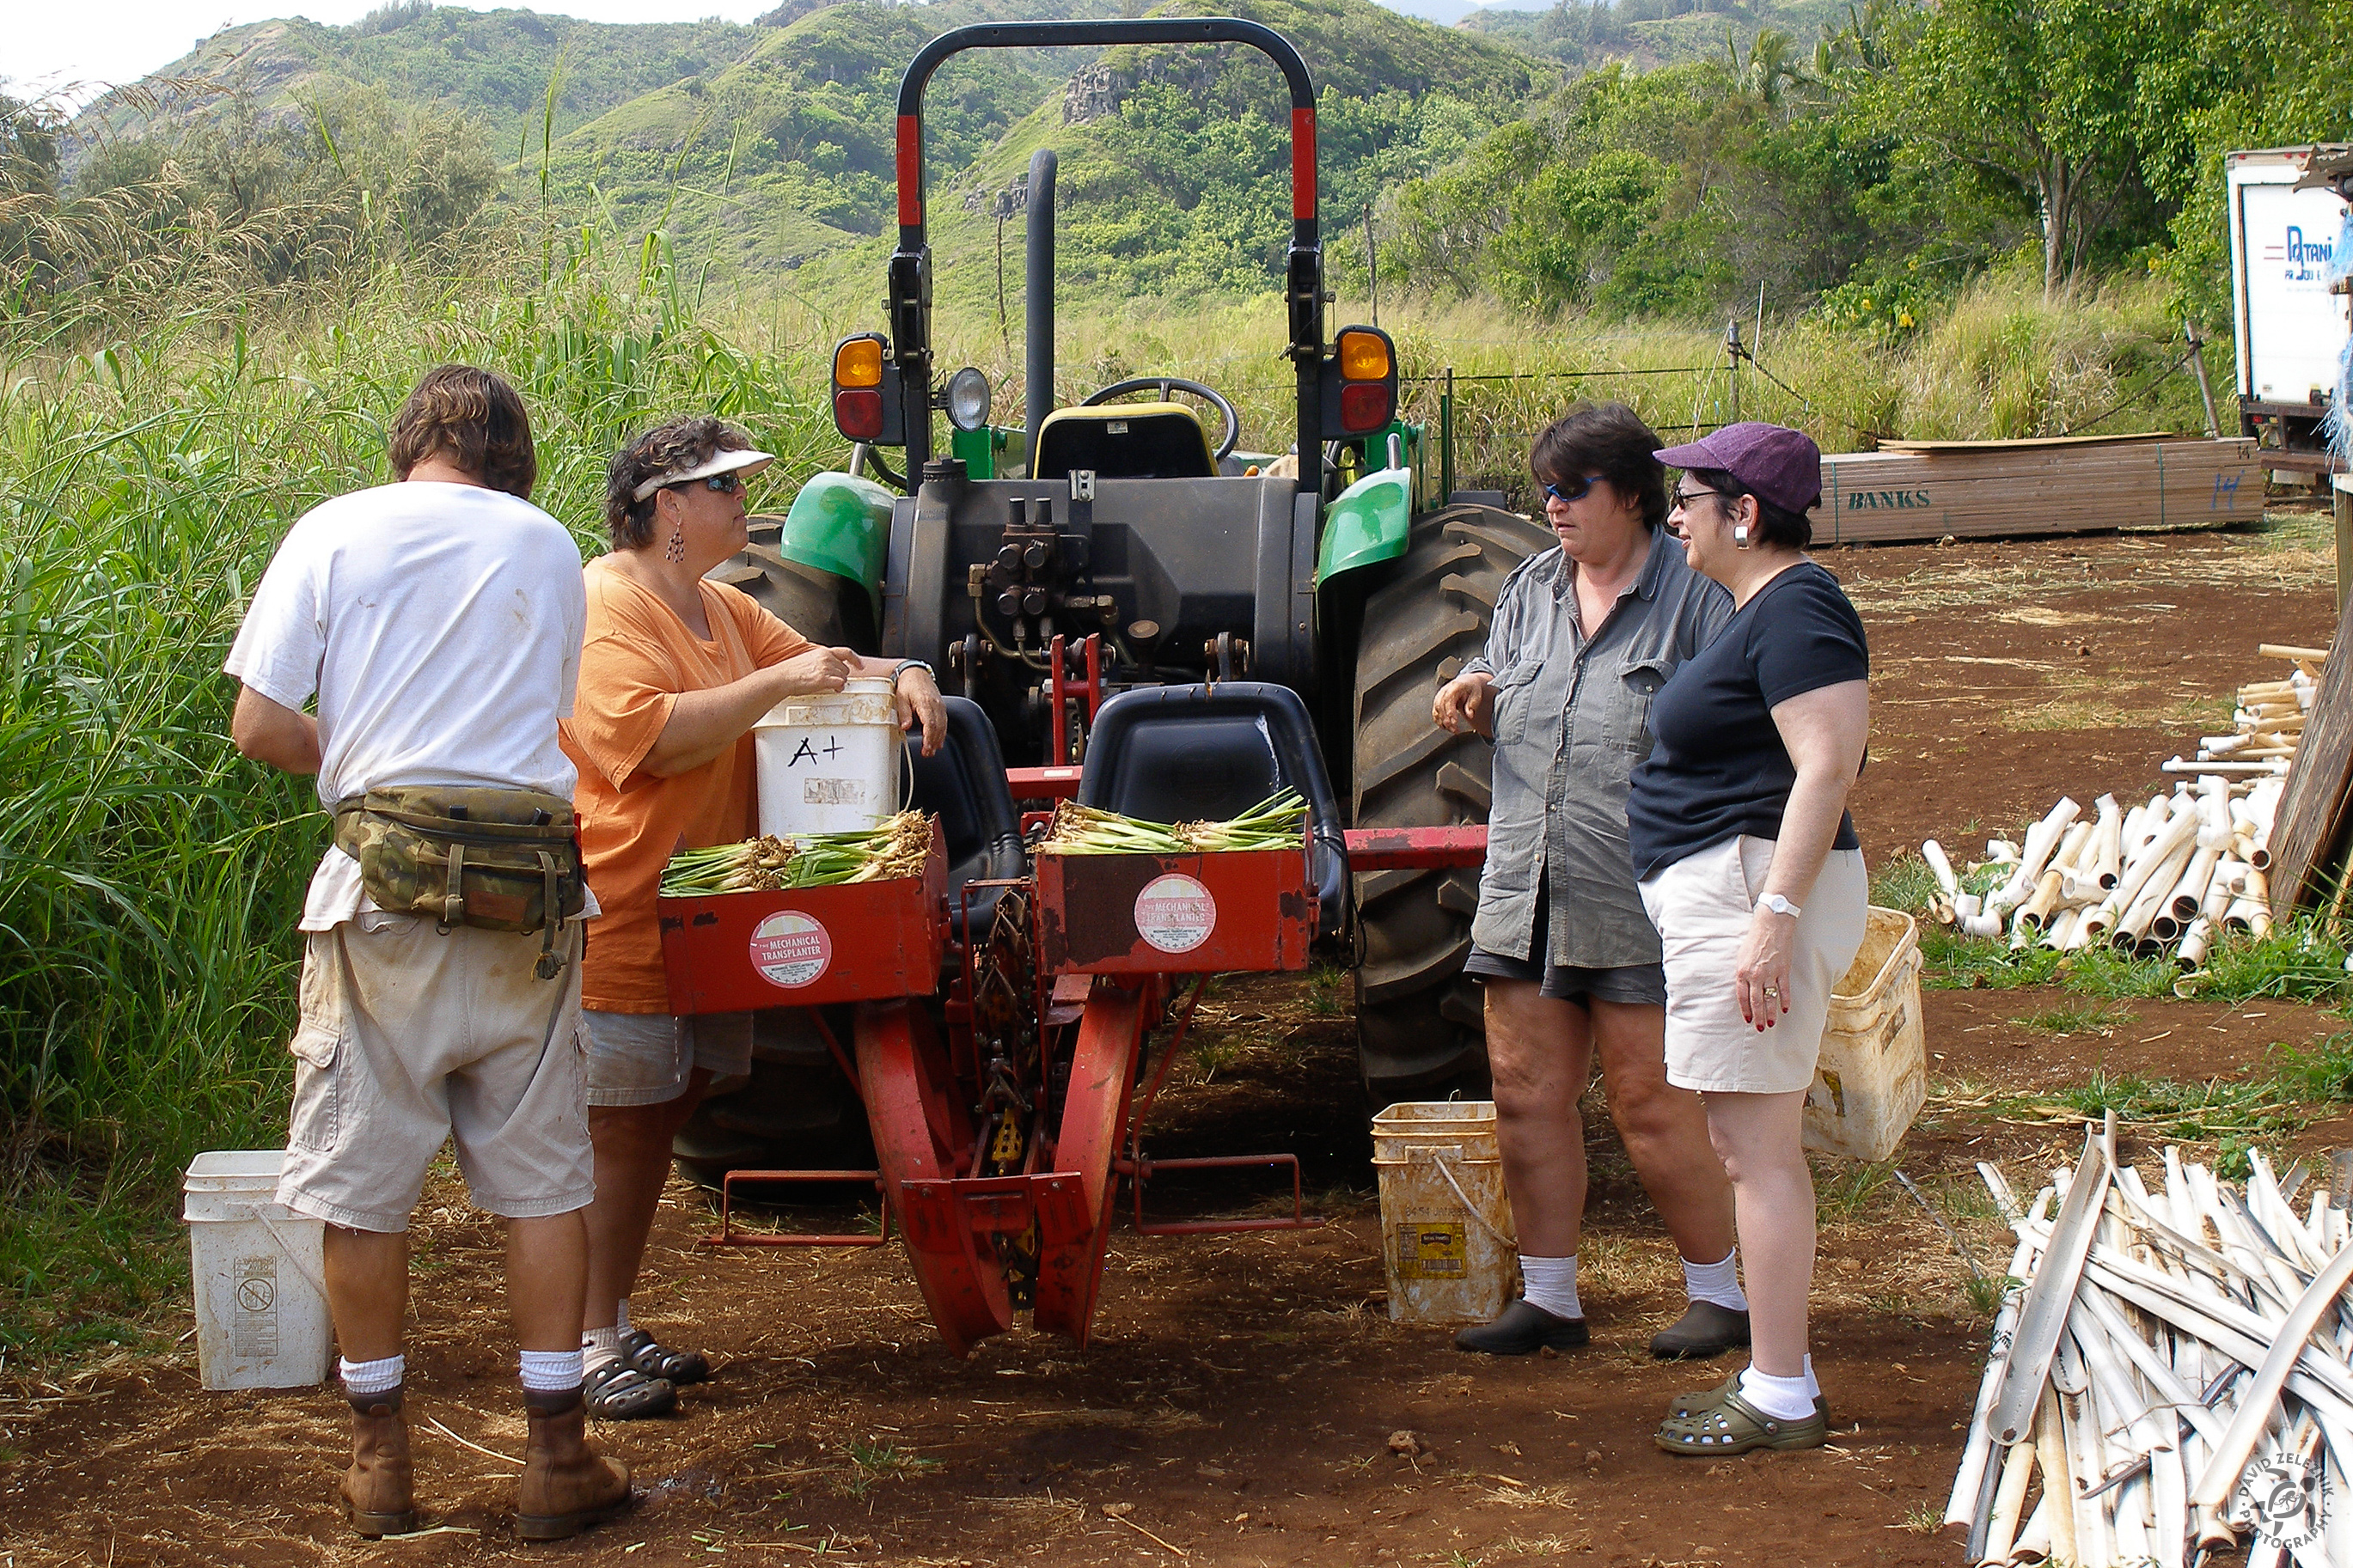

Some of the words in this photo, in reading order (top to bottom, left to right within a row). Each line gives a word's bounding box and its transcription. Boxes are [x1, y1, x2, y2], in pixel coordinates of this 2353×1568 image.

[2211, 469, 2245, 511] 14
[1847, 488, 1931, 510] BANKS
[787, 735, 844, 767] A+
[1155, 902, 1206, 912] MECHANICAL
[1146, 912, 1206, 922] TRANSPLANTER
[769, 935, 821, 950] MECHANICAL
[761, 946, 822, 961] TRANSPLANTER
